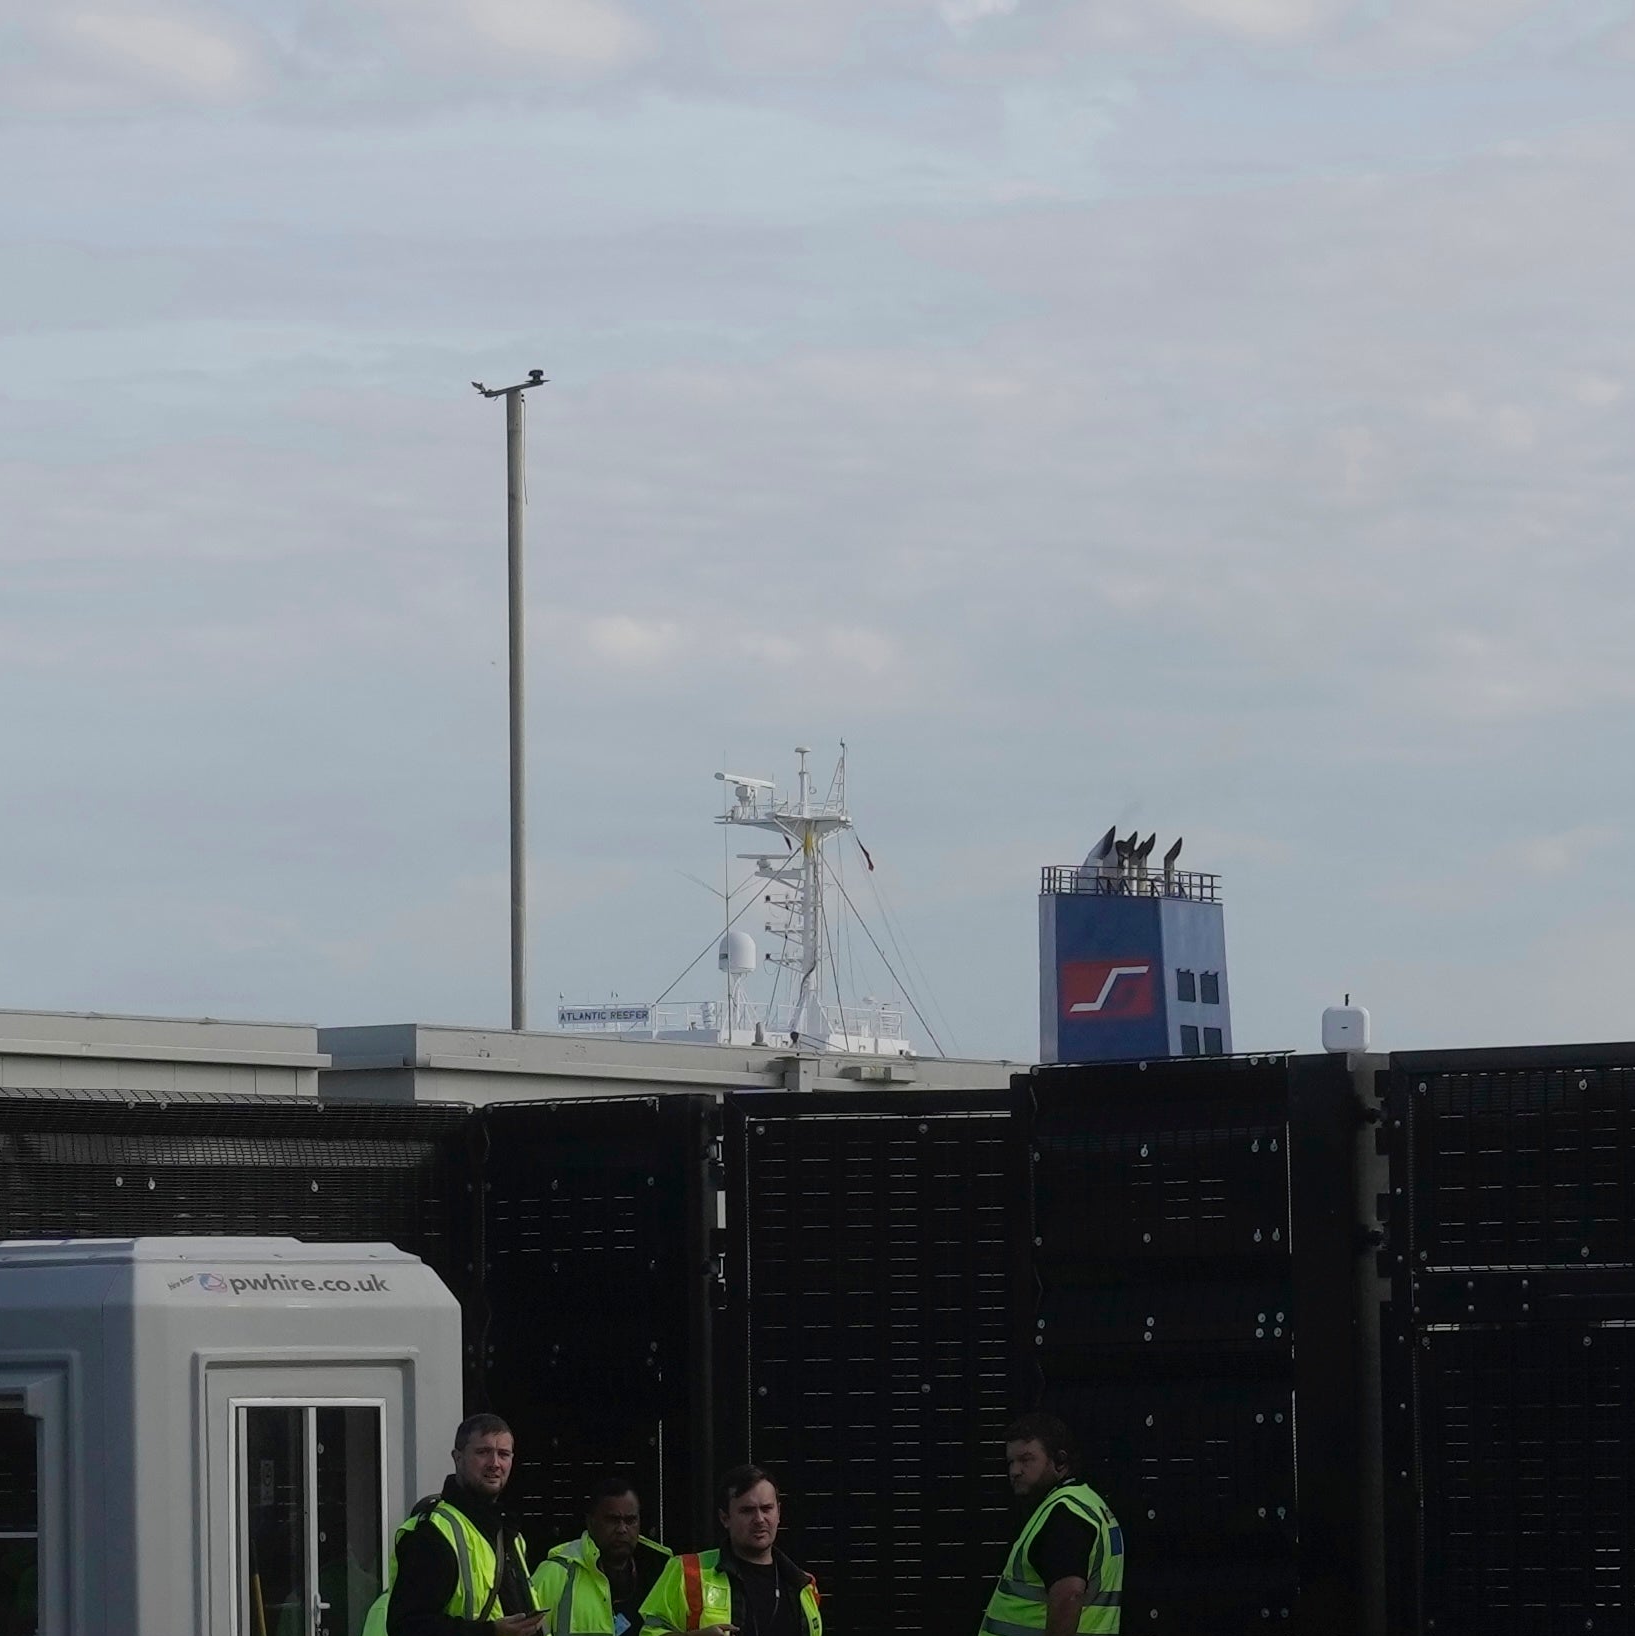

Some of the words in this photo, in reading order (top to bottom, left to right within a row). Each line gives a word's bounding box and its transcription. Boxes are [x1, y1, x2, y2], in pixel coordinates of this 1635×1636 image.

[560, 1011, 606, 1021] ATLANTIC
[610, 1010, 648, 1020] REEFER
[229, 1273, 391, 1295] pwhire.co.uk
